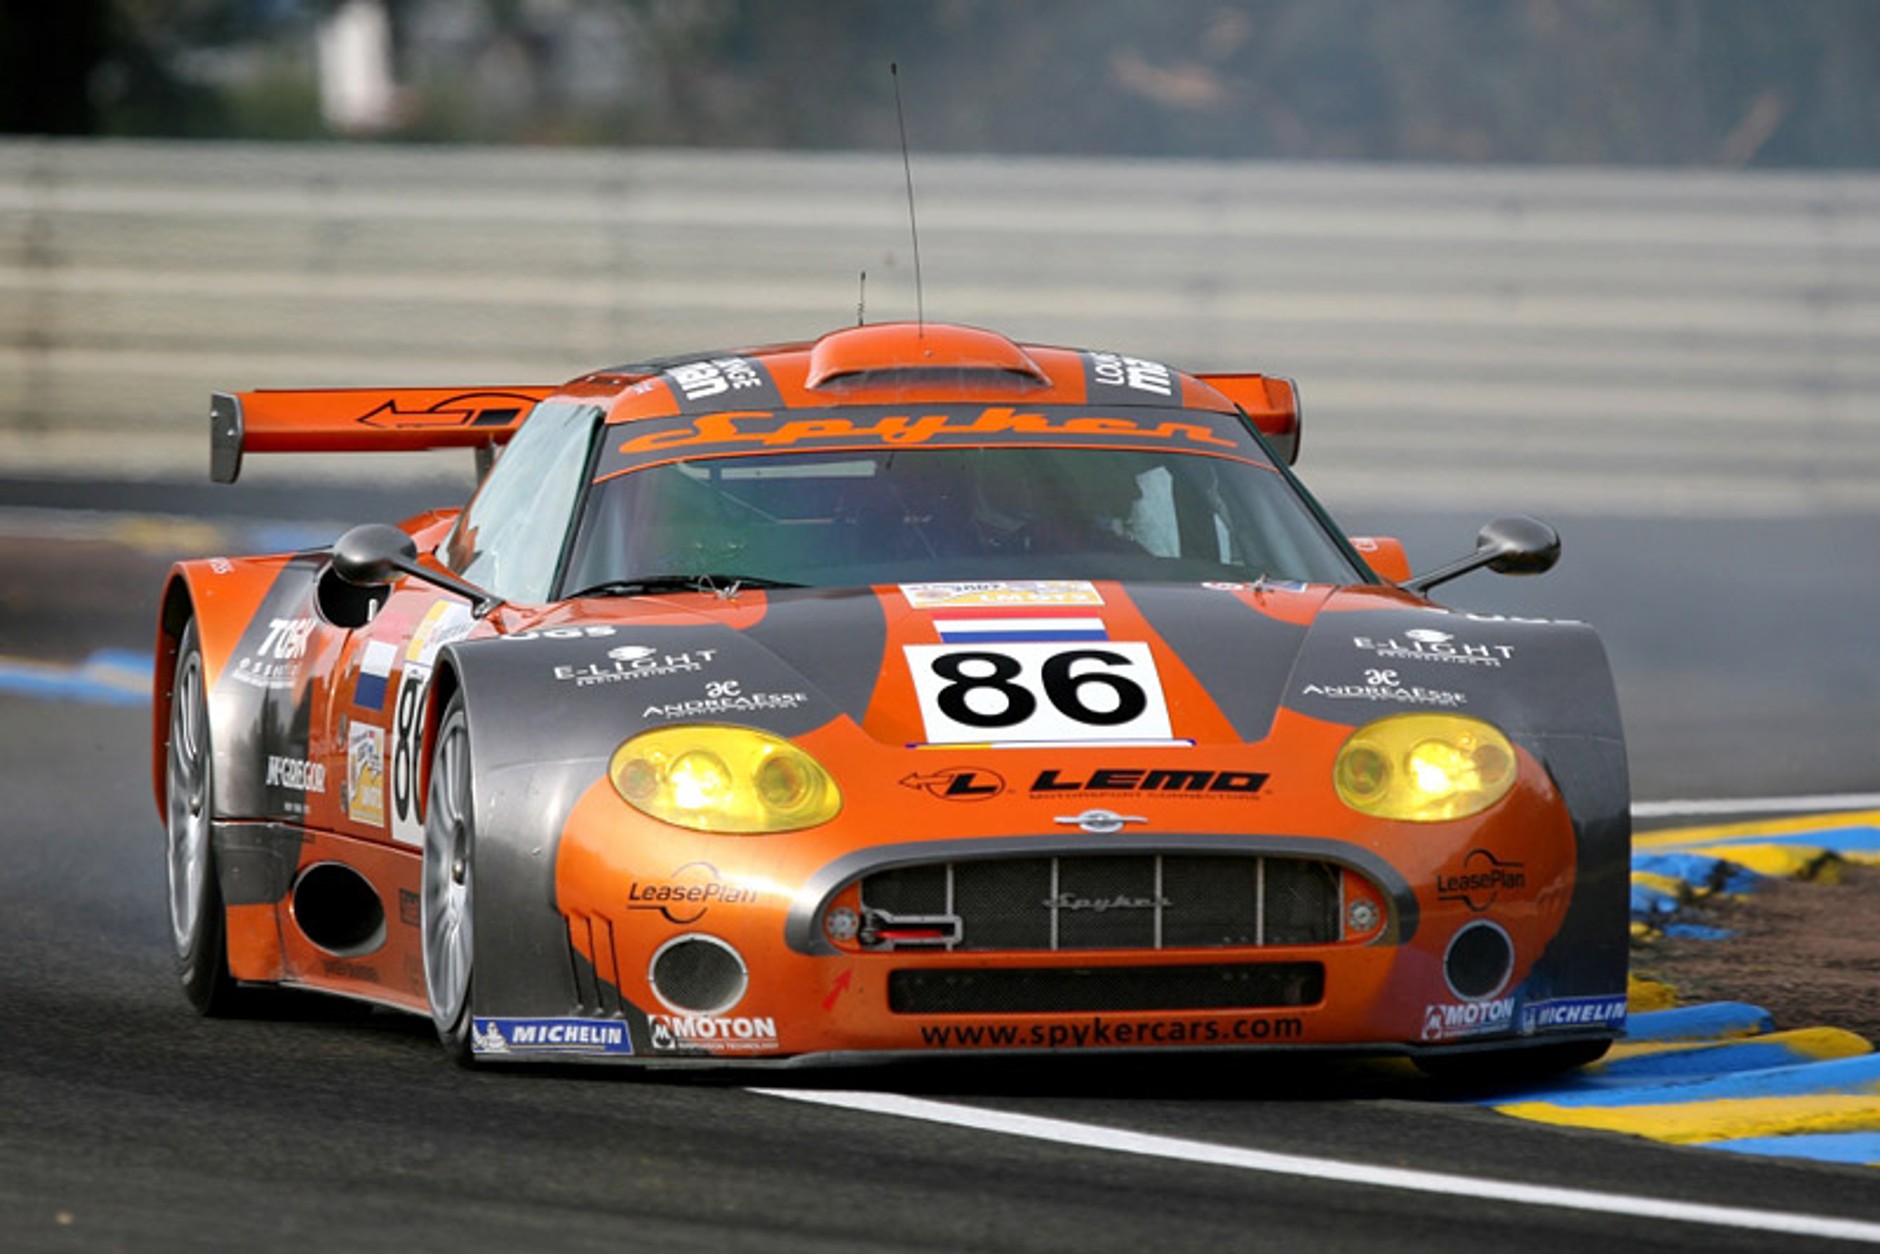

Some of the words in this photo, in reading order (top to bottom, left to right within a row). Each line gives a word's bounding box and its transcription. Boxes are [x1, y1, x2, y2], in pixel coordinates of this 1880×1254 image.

[619, 407, 1238, 454] Spyker
[1353, 637, 1514, 659] E-LIGHT
[554, 649, 717, 681] E-LIGHT
[931, 649, 1147, 728] 86
[1029, 769, 1270, 792] LEMO
[1437, 869, 1526, 893] LeasePlan
[628, 882, 757, 904] LeasePlan
[1445, 998, 1515, 1025] MOTON
[1537, 1002, 1627, 1025] MICHELIN
[511, 1023, 622, 1044] MICHELIN
[672, 1016, 777, 1038] MOTON
[921, 1016, 1303, 1048] www.spykercars.com
